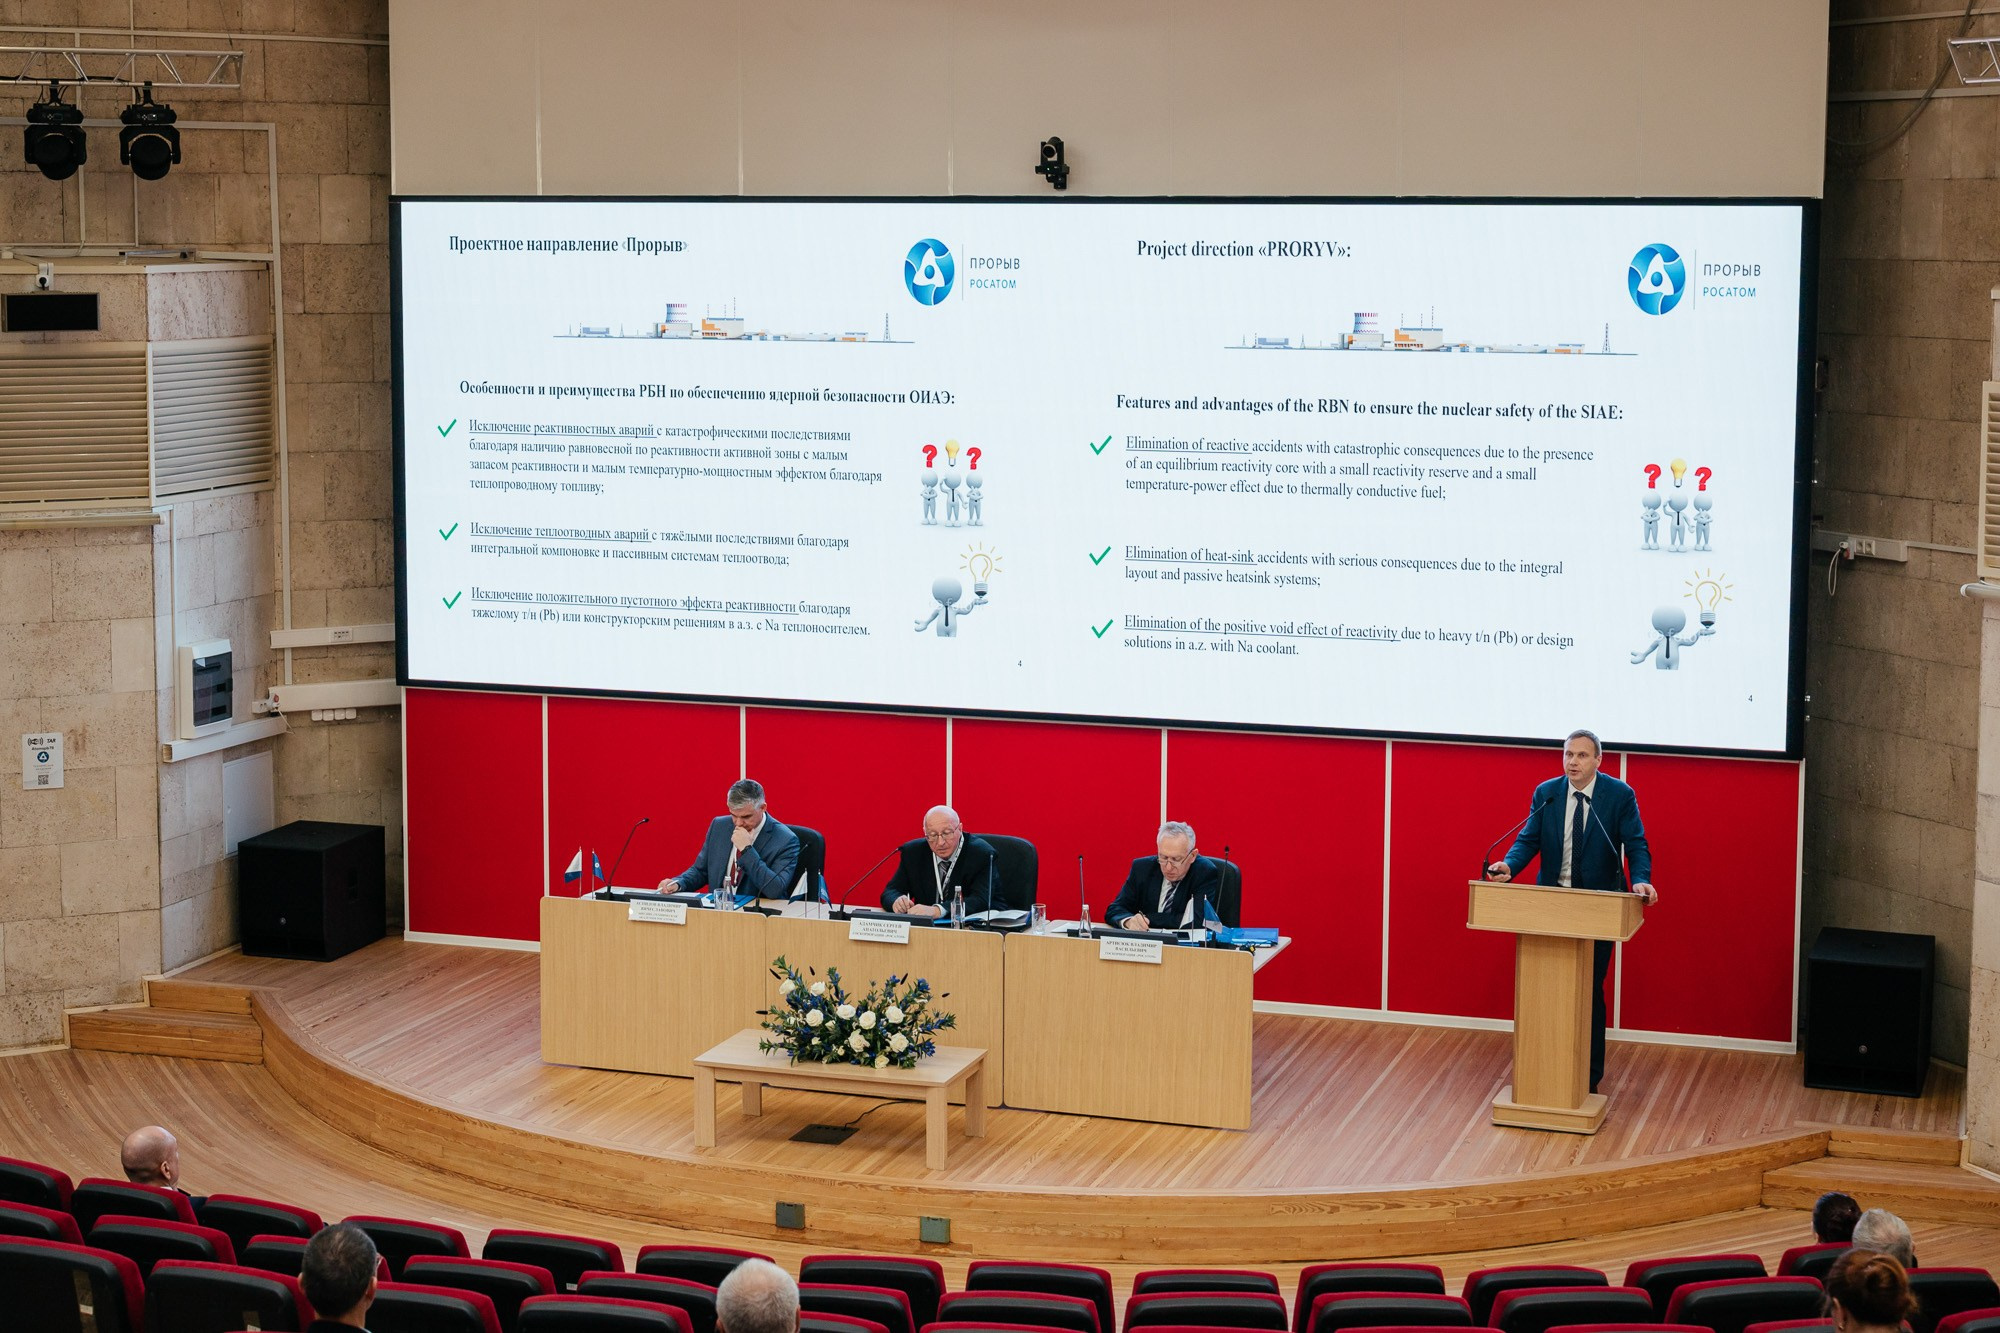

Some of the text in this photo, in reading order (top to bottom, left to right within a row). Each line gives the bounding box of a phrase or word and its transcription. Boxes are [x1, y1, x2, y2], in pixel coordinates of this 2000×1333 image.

[449, 235, 524, 255] Проектное
[526, 239, 619, 255] направление
[1137, 239, 1351, 260] Project direction «PRORYV»:
[969, 256, 1020, 270] ПРОРЫВ
[1703, 263, 1761, 277] ПРОРЫВ
[969, 278, 1016, 289] РОСАТОМ
[1702, 286, 1756, 297] РОСАТОМ
[459, 379, 955, 405] Особенности преимущества РБН обеспечению ядерной безопасности ОИАЭ:
[1116, 393, 1623, 422] Features and advantages of the RBN ensure the nuclear safety of the SIAE:
[468, 419, 851, 441] Исключение реактивностных аварий катастрофическими последствиями
[468, 437, 848, 461] благодаря наличию равновесной реактивности активной зоны малым
[1126, 435, 1594, 464] Elimination of reactive accidents with catastrophic consequences due the presence
[469, 460, 882, 485] запасом реактивности малым температурно-мощностным эффектом благодаря
[1125, 456, 1537, 480] of an equilibrium reactivity core with small reactivity reserve and small
[470, 480, 604, 496] теплопроводному топливу;
[1125, 478, 1446, 501] temperature-power effect due thermally conductive fuel;
[470, 521, 849, 551] Исключение теплоотводных аварий тяжёлыми последствиями благодаря
[470, 541, 789, 567] интегральной компоновке пассивным системам теплоотвода;
[1125, 545, 1563, 578] Elimination of heat-sink accidents with serious consequences due the integral
[1124, 565, 1321, 588] layout and passive heatsink systems;
[471, 586, 851, 618] Исключение положительного пустотного эффекта реактивности благодаря
[471, 609, 519, 622] тяжелому
[521, 608, 537, 620] т/н
[538, 607, 560, 624] (Pb)
[561, 612, 581, 622] или
[583, 614, 671, 629] конструкторским
[672, 618, 726, 632] решениям
[764, 618, 780, 631] Na
[781, 623, 870, 635] теплоносителем.
[1124, 614, 1574, 650] Elimination of the positive void effect of reactivity due heavy t/n (Pb) or design
[1123, 634, 1299, 655] solutions in a.z. with Na coolant.
[1748, 694, 1753, 702] 4
